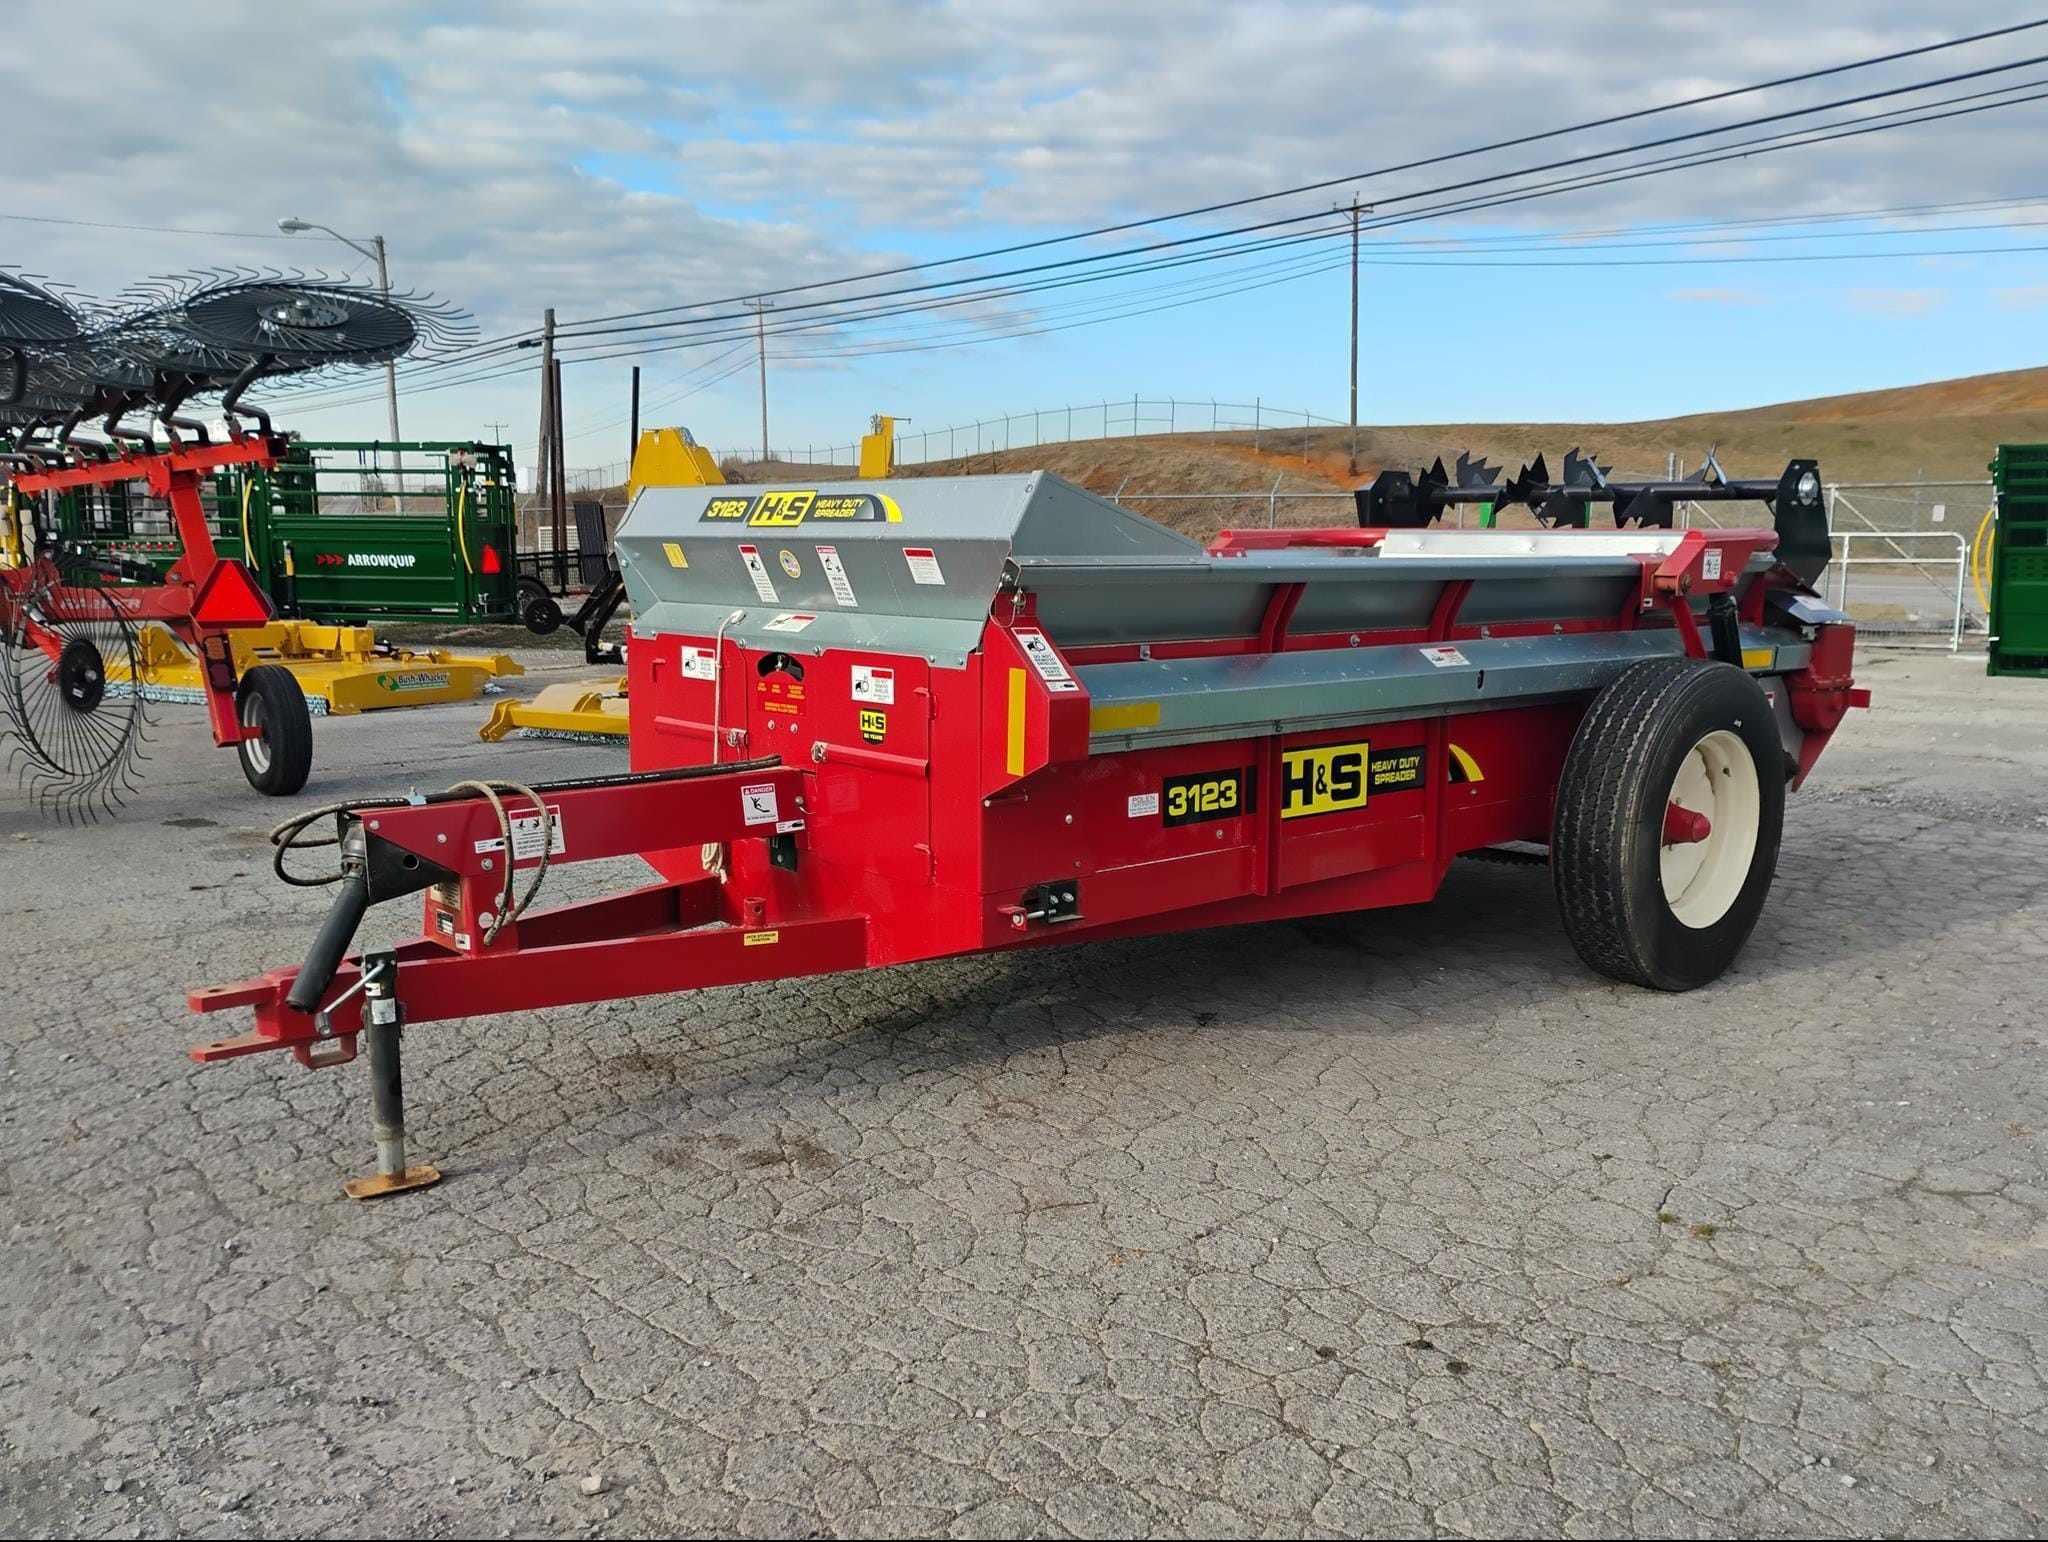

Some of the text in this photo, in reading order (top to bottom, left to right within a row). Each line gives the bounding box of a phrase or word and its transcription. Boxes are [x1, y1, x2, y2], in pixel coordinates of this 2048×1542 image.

[707, 496, 809, 521] 3123 H&S
[815, 499, 865, 509] HEAVY DUTY
[813, 509, 856, 518] SPREADER
[348, 554, 416, 568] ARROWQUIP
[398, 672, 448, 685] Bush-Whacker
[862, 713, 884, 730] H&S
[1371, 756, 1420, 773] HEAVY DUTY
[1281, 753, 1362, 809] H&S
[1374, 769, 1416, 785] SPREADER
[750, 786, 773, 794] DANGER
[1168, 779, 1237, 816] 3123
